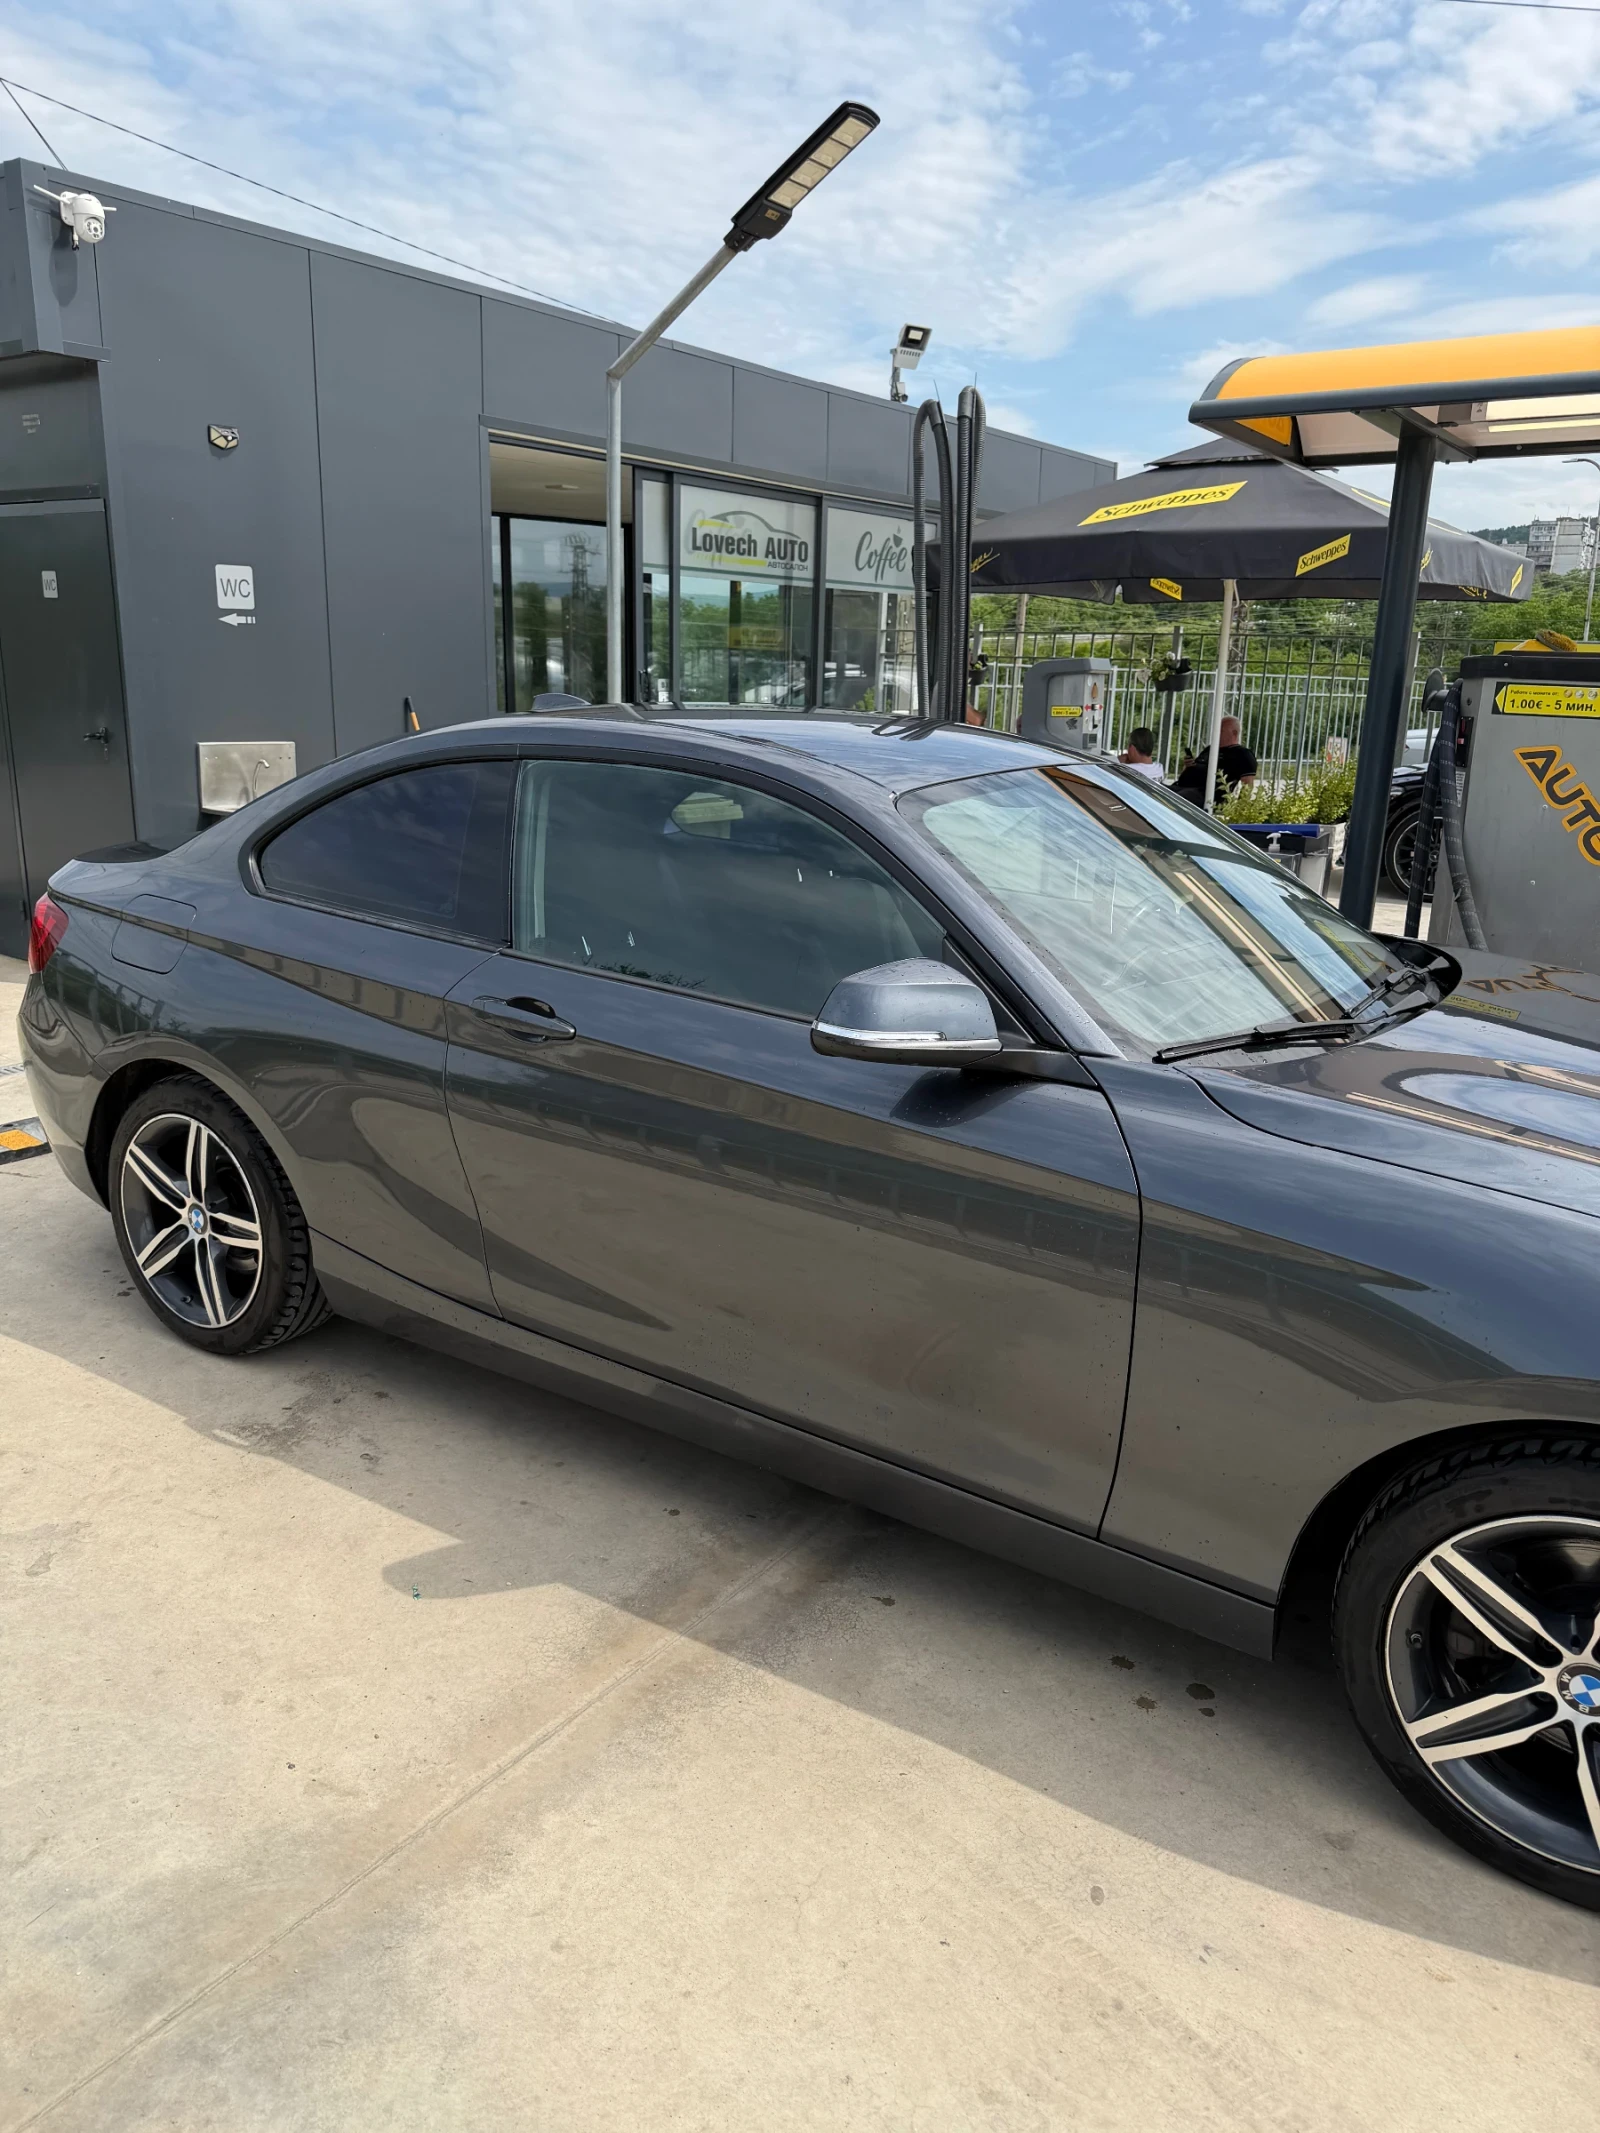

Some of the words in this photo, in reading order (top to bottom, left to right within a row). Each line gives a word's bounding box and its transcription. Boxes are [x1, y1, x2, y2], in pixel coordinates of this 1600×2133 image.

[1095, 488, 1231, 519] Schweppes
[691, 527, 758, 557] Lovech
[764, 537, 809, 563] AUTO
[855, 531, 908, 583] Coffee
[1299, 541, 1347, 570] Schweppes
[43, 578, 57, 592] WC
[220, 577, 251, 598] WC
[1509, 698, 1544, 710] 1.00€
[1554, 700, 1563, 710] 5
[1565, 703, 1597, 712] мин.
[1560, 1671, 1590, 1714] BMW
